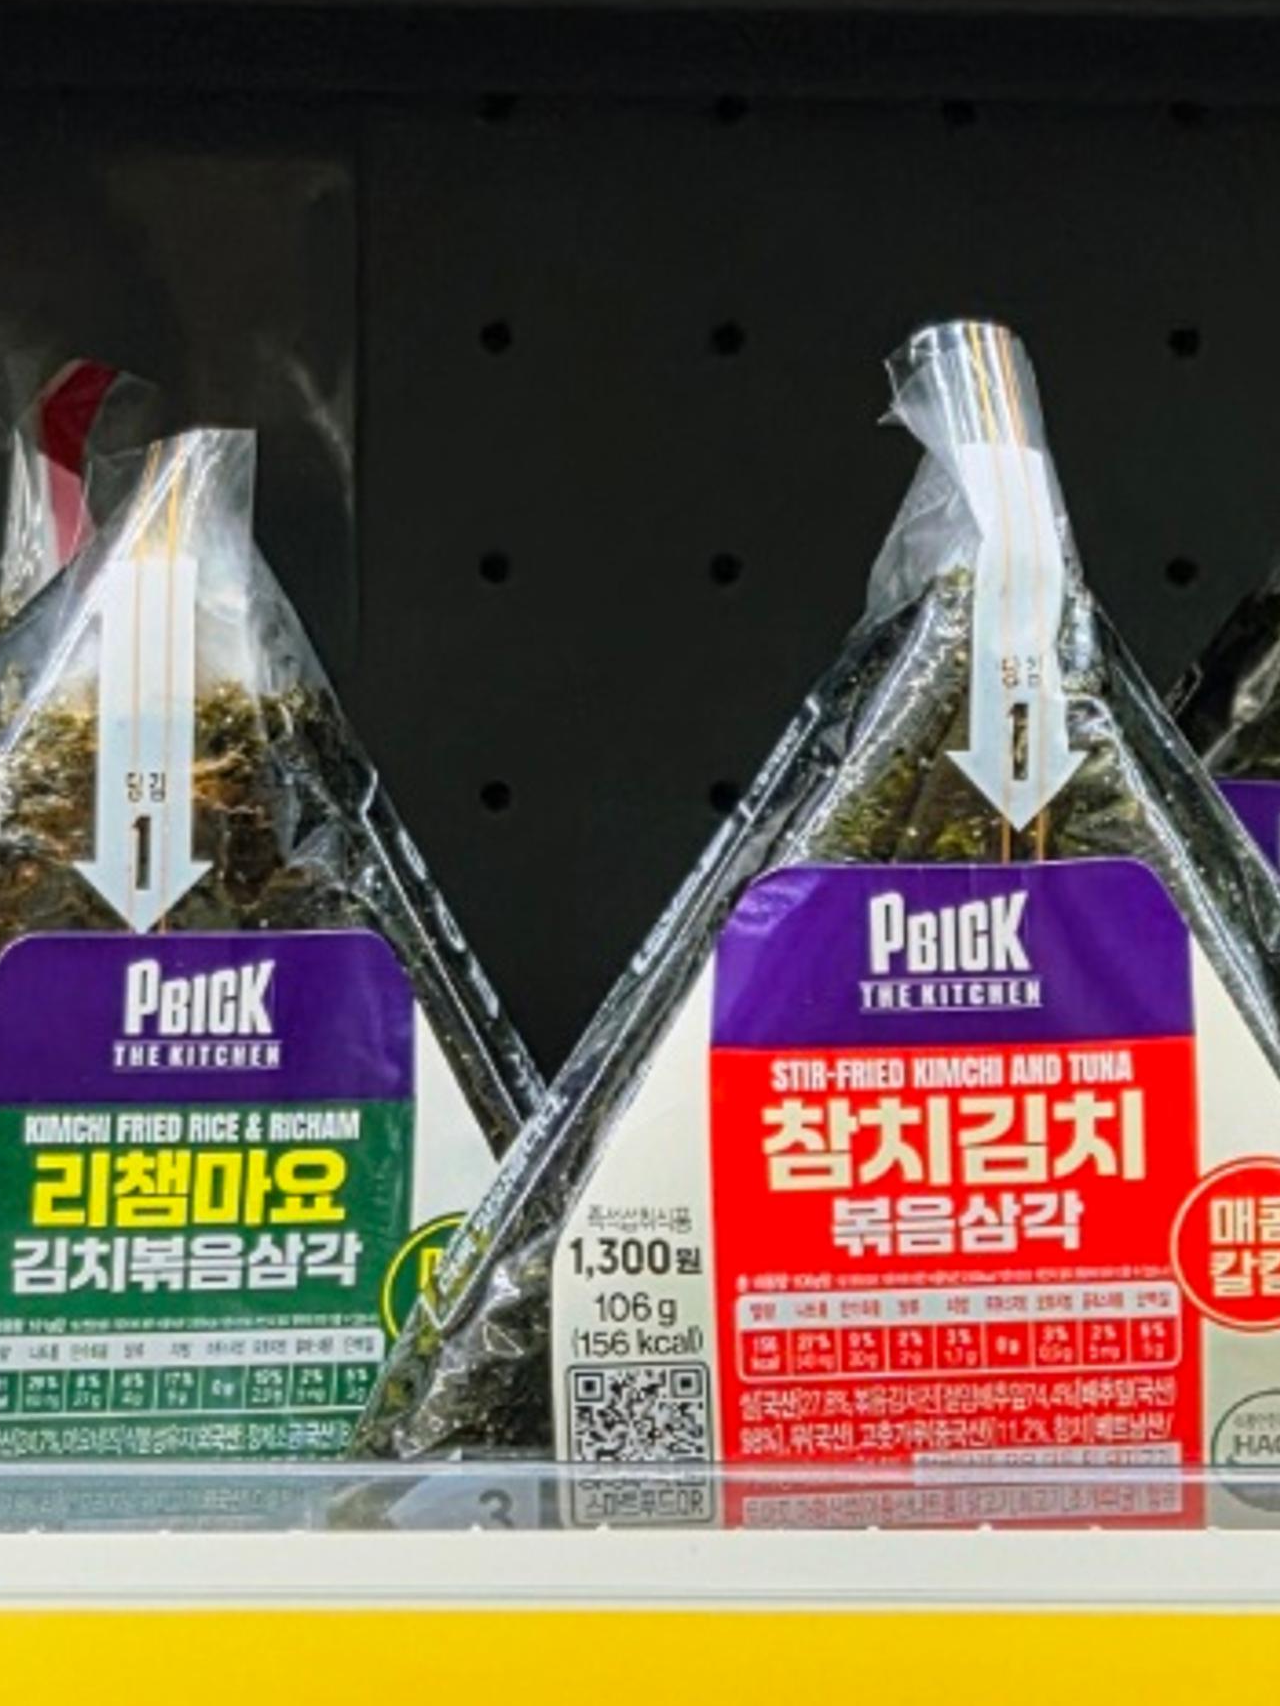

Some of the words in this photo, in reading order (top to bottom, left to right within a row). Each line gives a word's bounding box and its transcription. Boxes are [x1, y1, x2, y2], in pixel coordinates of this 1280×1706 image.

[1007, 702, 1029, 781] 1
[131, 814, 153, 892] 1
[868, 891, 1033, 975] PBICK
[123, 958, 276, 1037] PBICK
[861, 983, 915, 1010] THE
[919, 981, 1041, 1008] KITCHEN
[114, 1043, 161, 1067] THE
[169, 1042, 281, 1068] KITCHEN
[772, 1058, 906, 1093] STIR-FRIED
[913, 1057, 1004, 1091] KIMCHI
[1009, 1055, 1062, 1087] AND
[1069, 1052, 1133, 1085] TUNA
[25, 1115, 111, 1144] KIMCHI
[119, 1114, 181, 1143] FRIED
[189, 1113, 240, 1143] RICE
[245, 1113, 262, 1141] &
[270, 1110, 360, 1140] RICHAM
[760, 1091, 1147, 1193] 참치김치
[31, 1148, 348, 1228] 리챔마요
[831, 1192, 1084, 1257] 볶음삼각
[12, 1233, 363, 1295] 김치볶음삼각
[569, 1238, 703, 1279] 1,300원
[571, 1326, 631, 1358] (156
[636, 1324, 704, 1355] kcal)
[594, 1293, 652, 1323] 106
[657, 1301, 678, 1328] g
